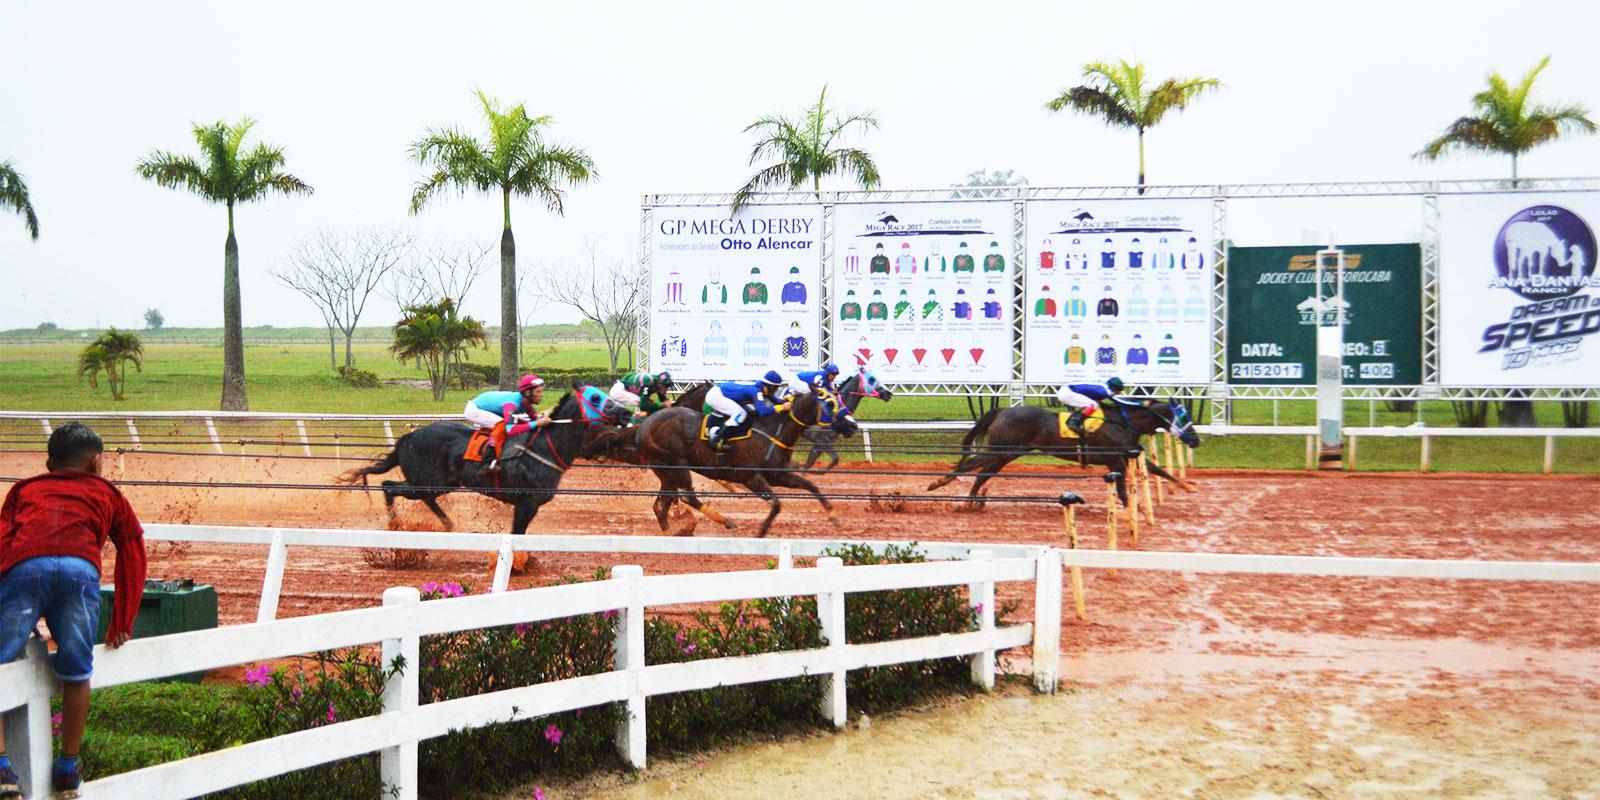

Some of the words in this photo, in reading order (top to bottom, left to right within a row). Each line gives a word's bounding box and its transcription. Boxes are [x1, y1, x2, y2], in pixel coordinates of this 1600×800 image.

[660, 219, 687, 235] GP
[690, 219, 747, 235] MEGA
[752, 218, 814, 235] DERBY
[907, 223, 923, 231] 2017
[1103, 220, 1119, 228] 2017
[720, 237, 752, 250] Otto
[757, 236, 813, 250] Alencar
[1256, 272, 1293, 285] JOCKEY
[1295, 271, 1317, 284] CLU
[1342, 270, 1392, 283] OROCABA
[1488, 276, 1525, 289] ANA
[1531, 274, 1600, 288] DANTAS
[1510, 294, 1590, 320] DREAM
[1476, 308, 1600, 354] SPEED
[1241, 343, 1283, 357] DATA:
[1375, 344, 1383, 354] 6
[1361, 365, 1392, 376] 402
